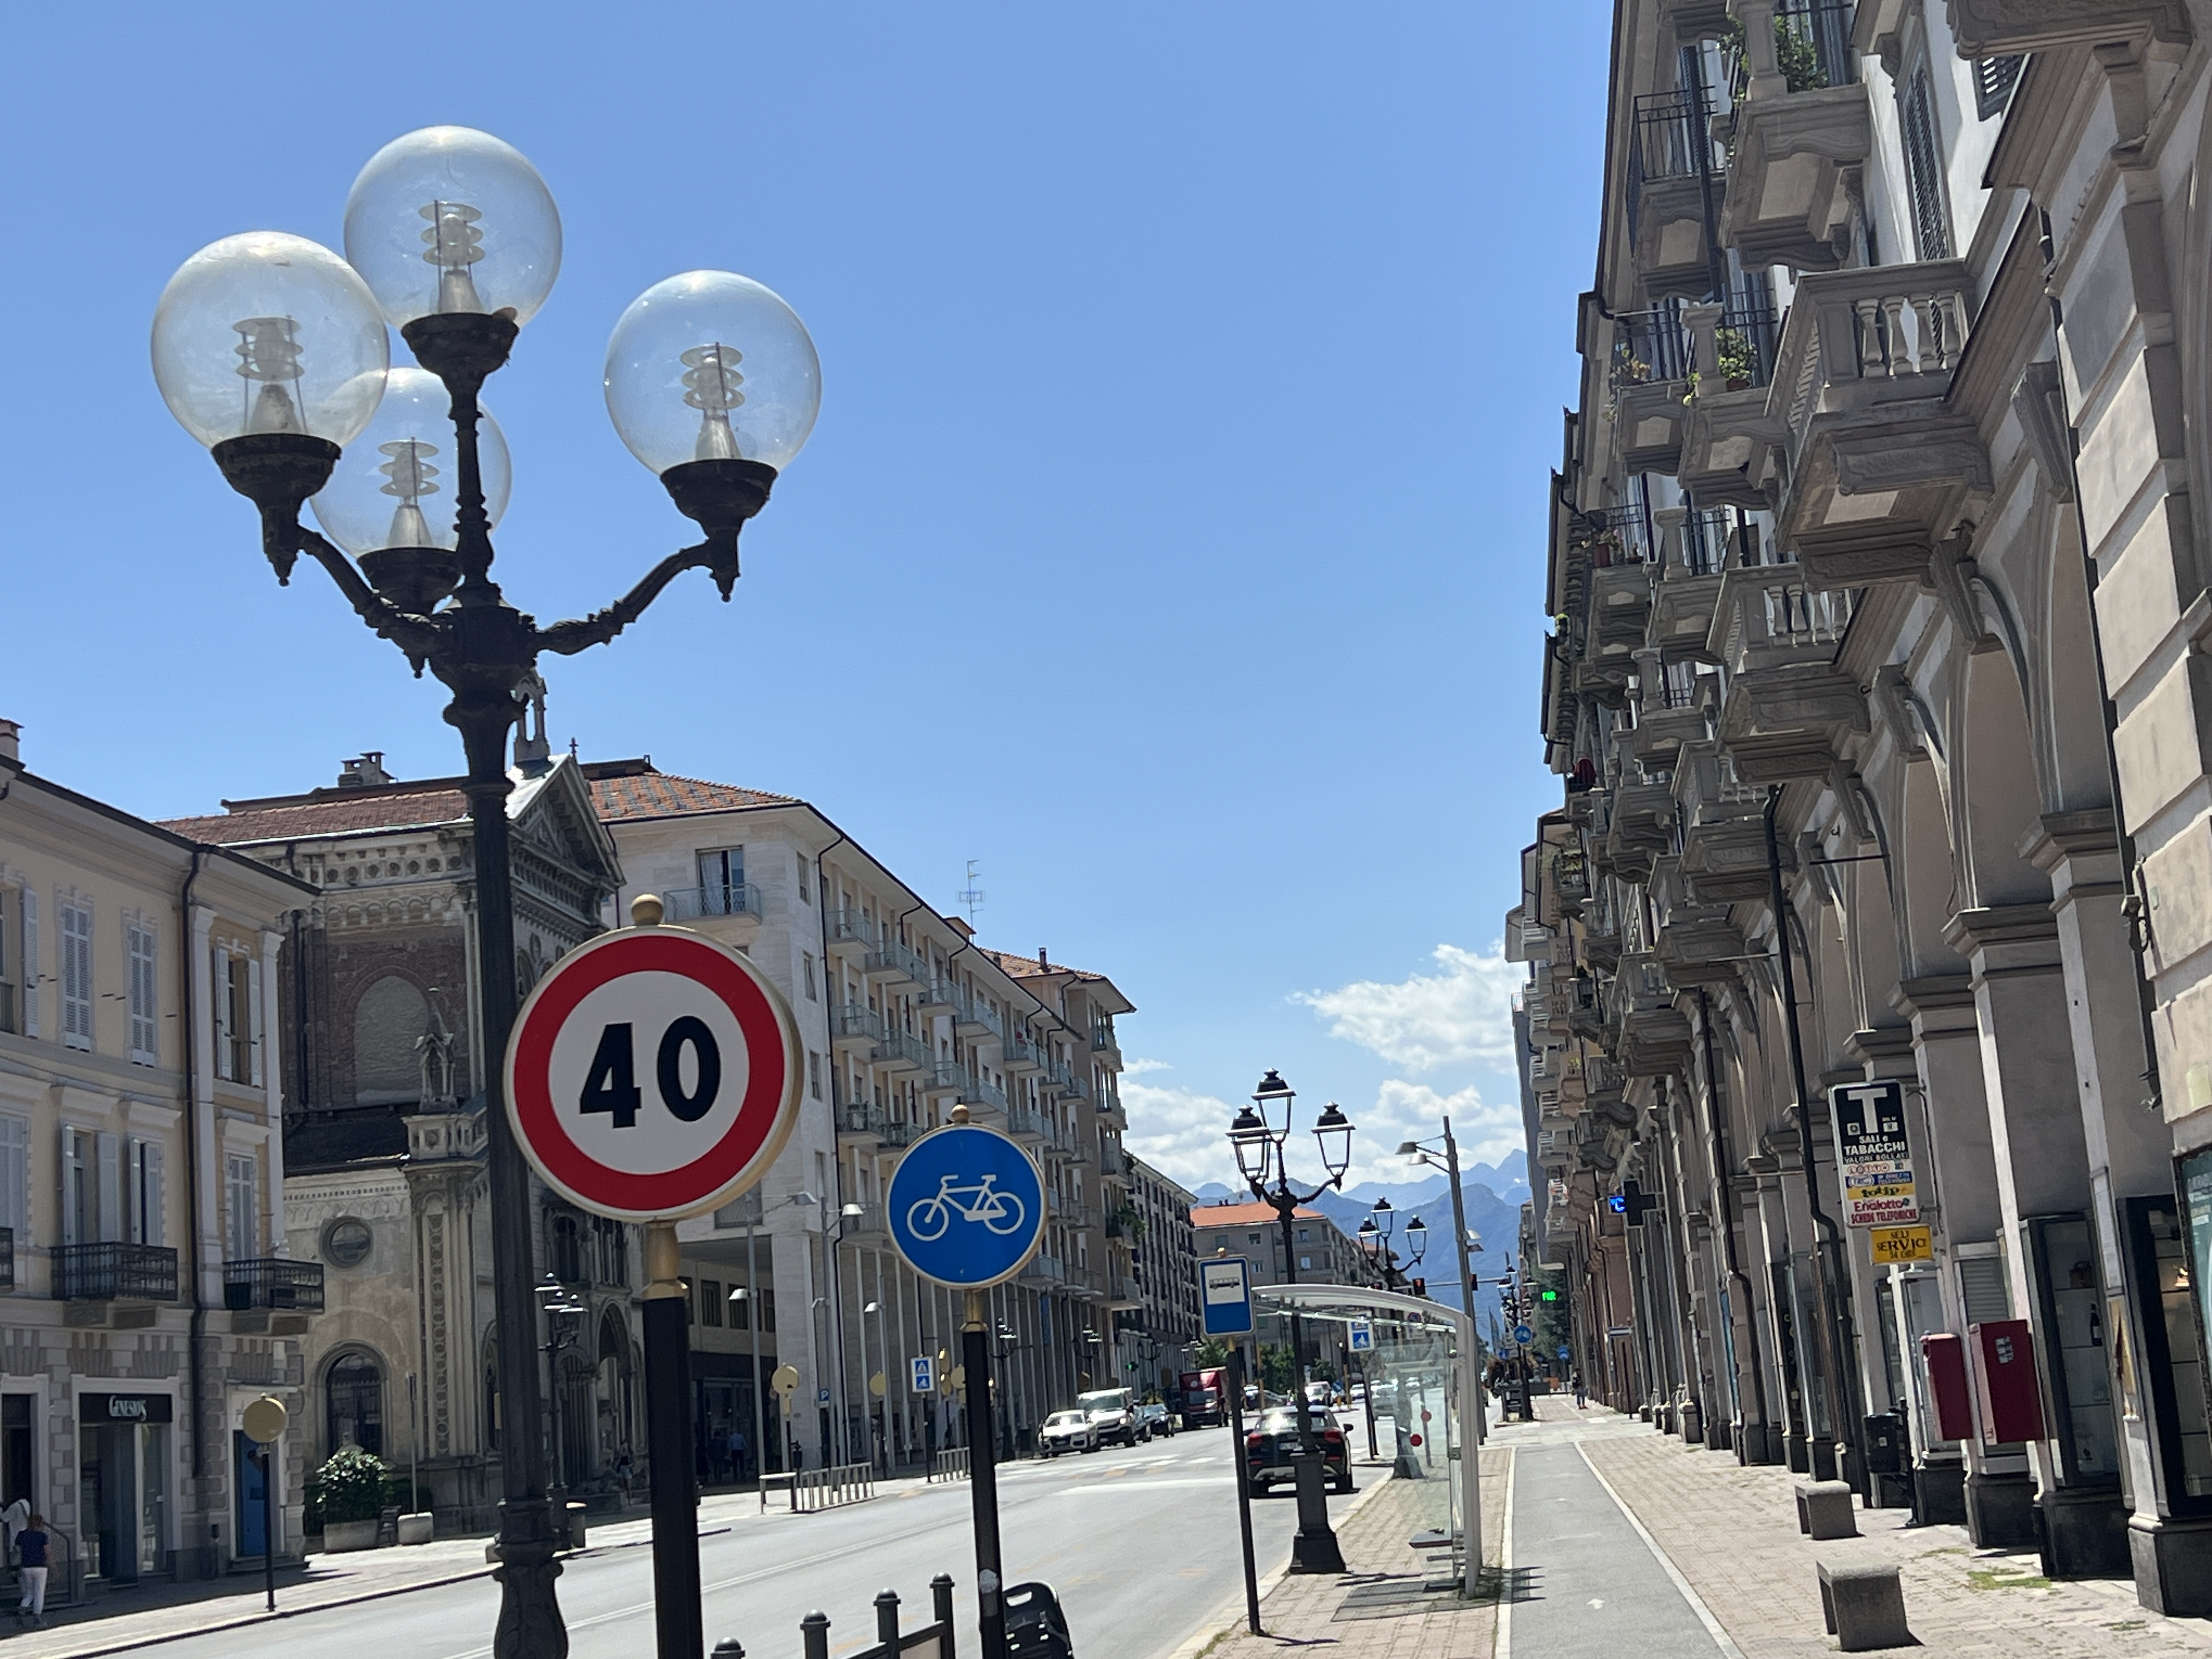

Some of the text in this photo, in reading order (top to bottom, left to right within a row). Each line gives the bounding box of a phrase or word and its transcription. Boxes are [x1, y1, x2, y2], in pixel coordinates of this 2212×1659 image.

[579, 1015, 721, 1128] 40
[1847, 1087, 1888, 1133] T
[1859, 1135, 1880, 1143] SALI
[1844, 1141, 1905, 1155] TABACCHI
[821, 1390, 828, 1400] P
